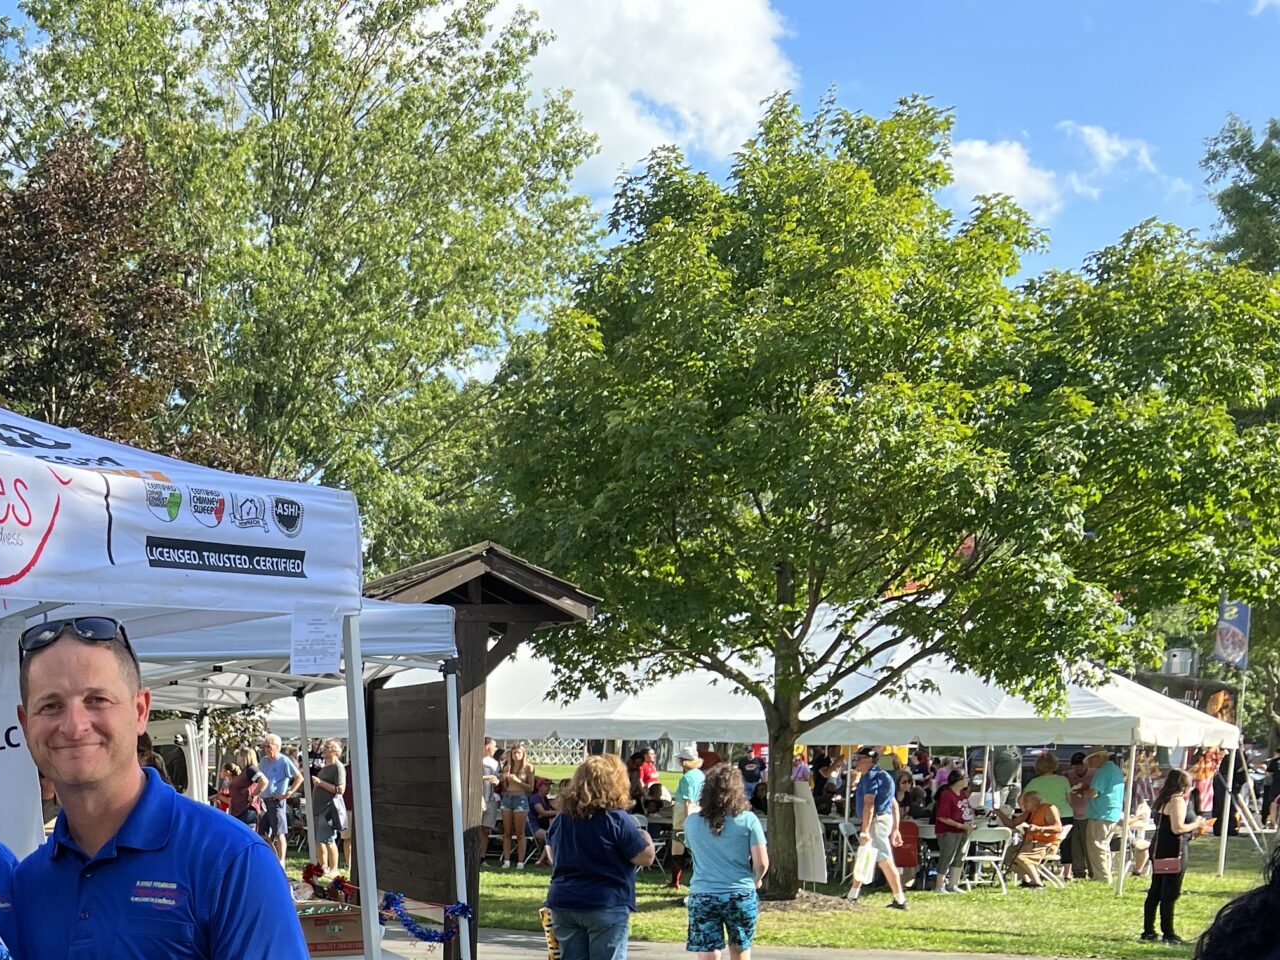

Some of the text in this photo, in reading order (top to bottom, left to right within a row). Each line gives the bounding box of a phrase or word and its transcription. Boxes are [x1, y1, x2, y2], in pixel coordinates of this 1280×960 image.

[276, 502, 299, 517] ASHI
[147, 546, 302, 573] LICENSED. TRUSTED. CERTIFIED
